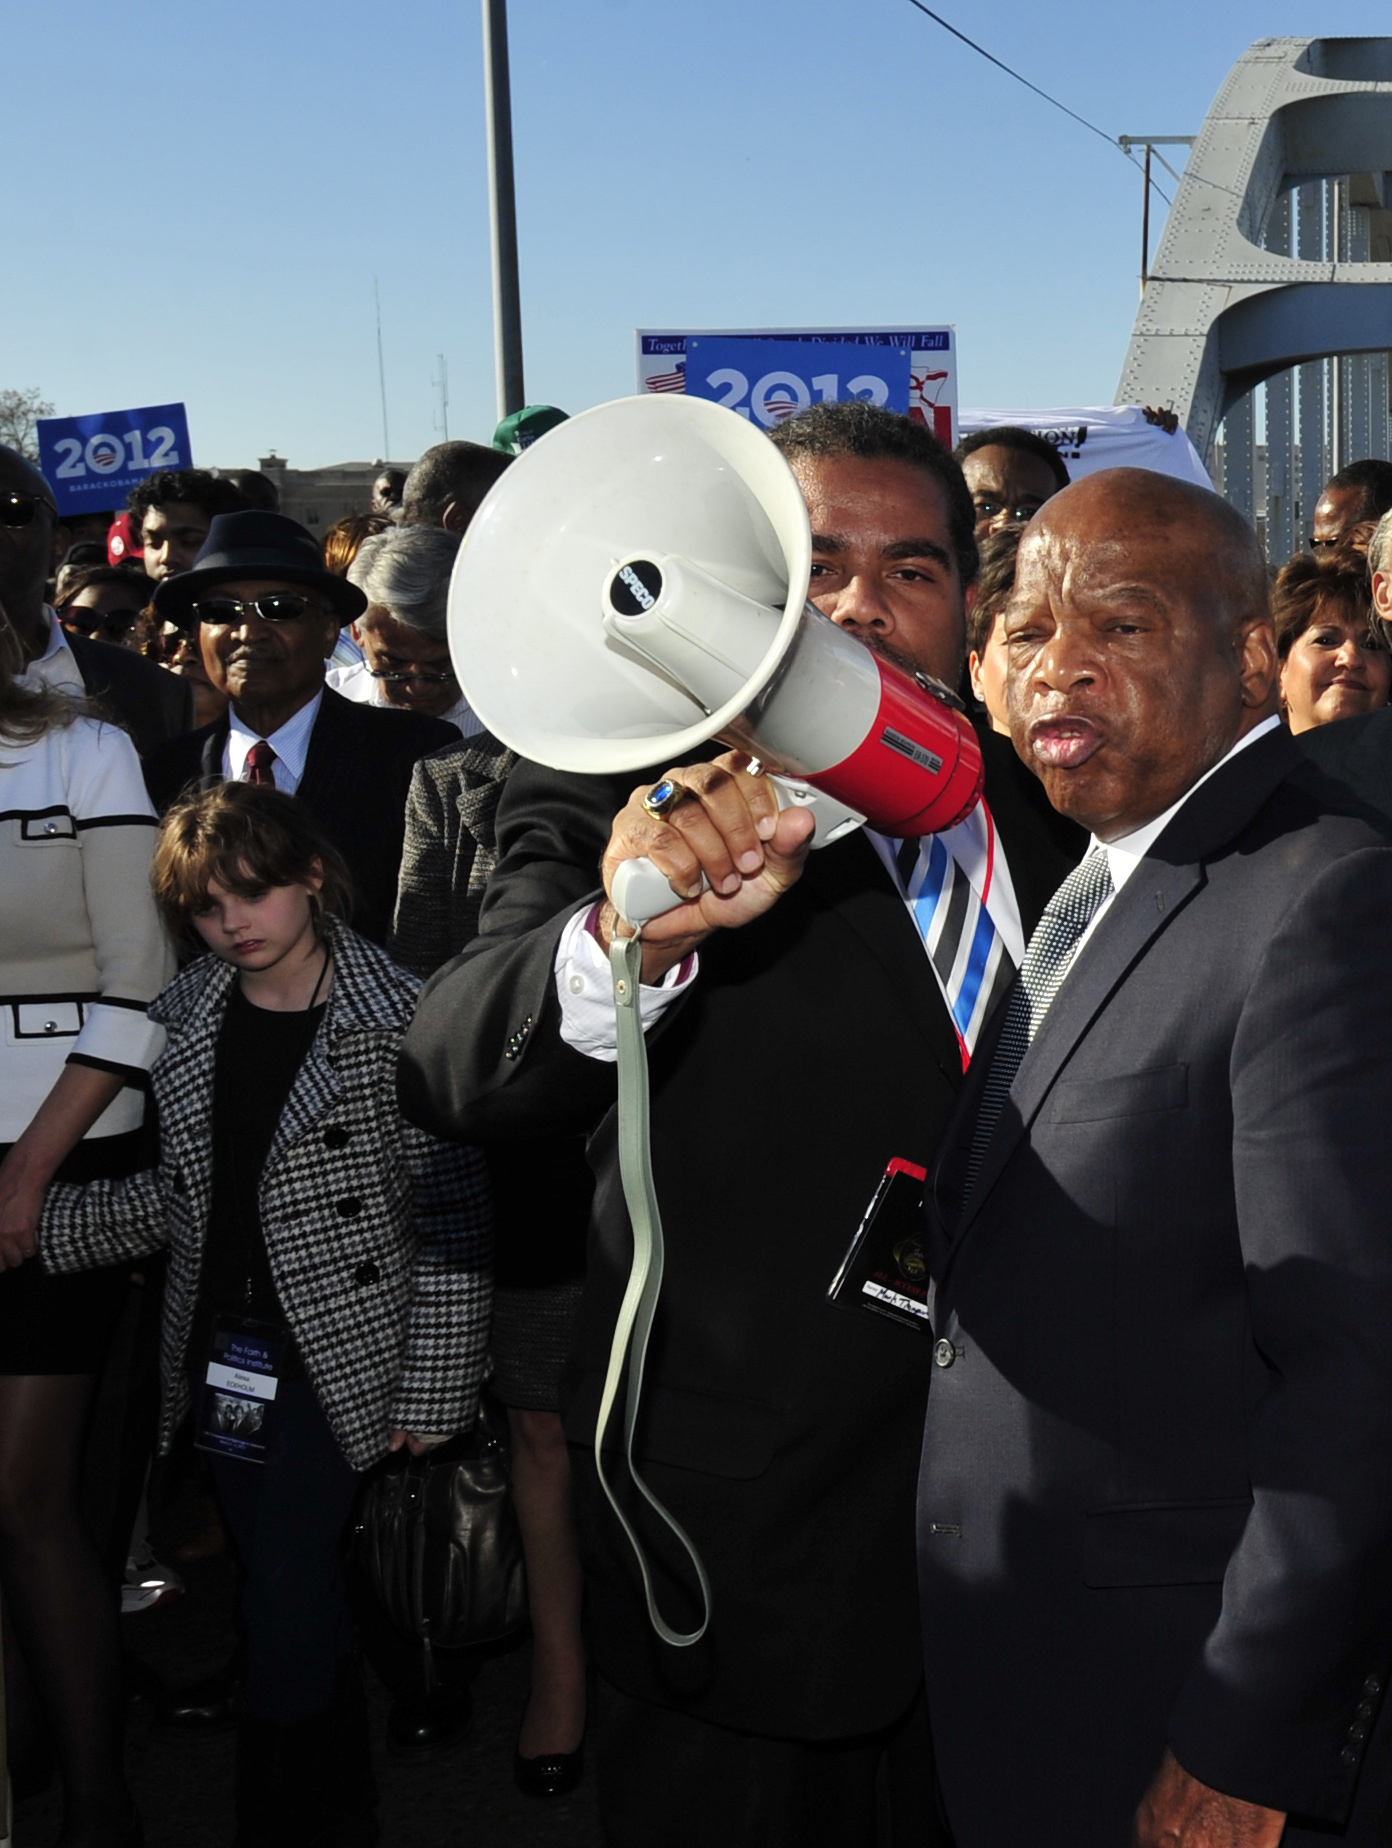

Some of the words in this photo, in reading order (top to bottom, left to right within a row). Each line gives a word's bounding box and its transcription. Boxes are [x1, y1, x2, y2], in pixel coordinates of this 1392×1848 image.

[889, 335, 915, 347] Will
[920, 334, 944, 347] Fall
[706, 368, 889, 423] 2012
[53, 426, 180, 479] 2012
[618, 565, 655, 610] SPECO
